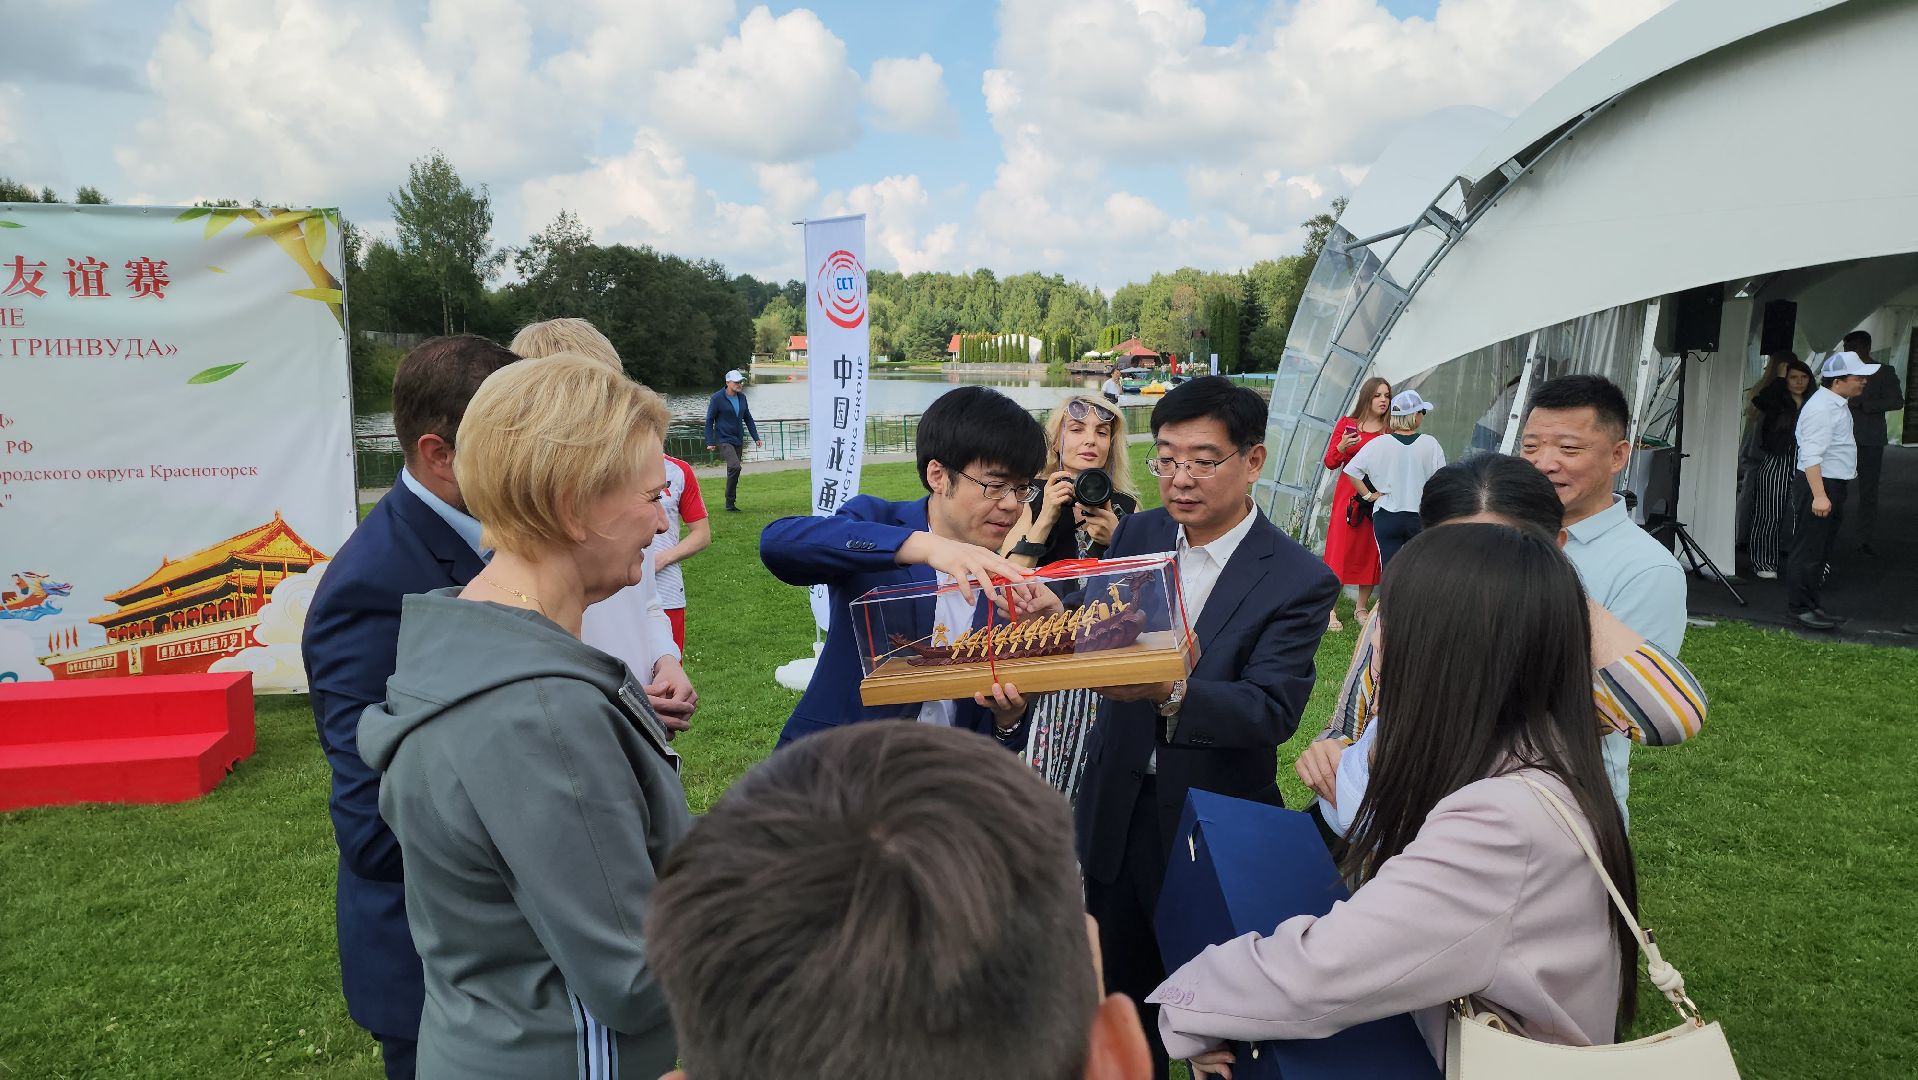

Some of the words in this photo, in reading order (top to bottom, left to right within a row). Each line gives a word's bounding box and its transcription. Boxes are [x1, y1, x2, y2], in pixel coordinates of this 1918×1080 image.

[2, 255, 171, 299] 友谊赛
[836, 277, 853, 290] CCT
[11, 338, 178, 360] ГРИНВУДА»
[839, 428, 858, 507] NGTONG
[854, 356, 863, 421] GROUP
[6, 440, 33, 454] РФ
[0, 469, 82, 484] родского
[87, 467, 145, 482] округа
[150, 464, 258, 481] Красногорск
